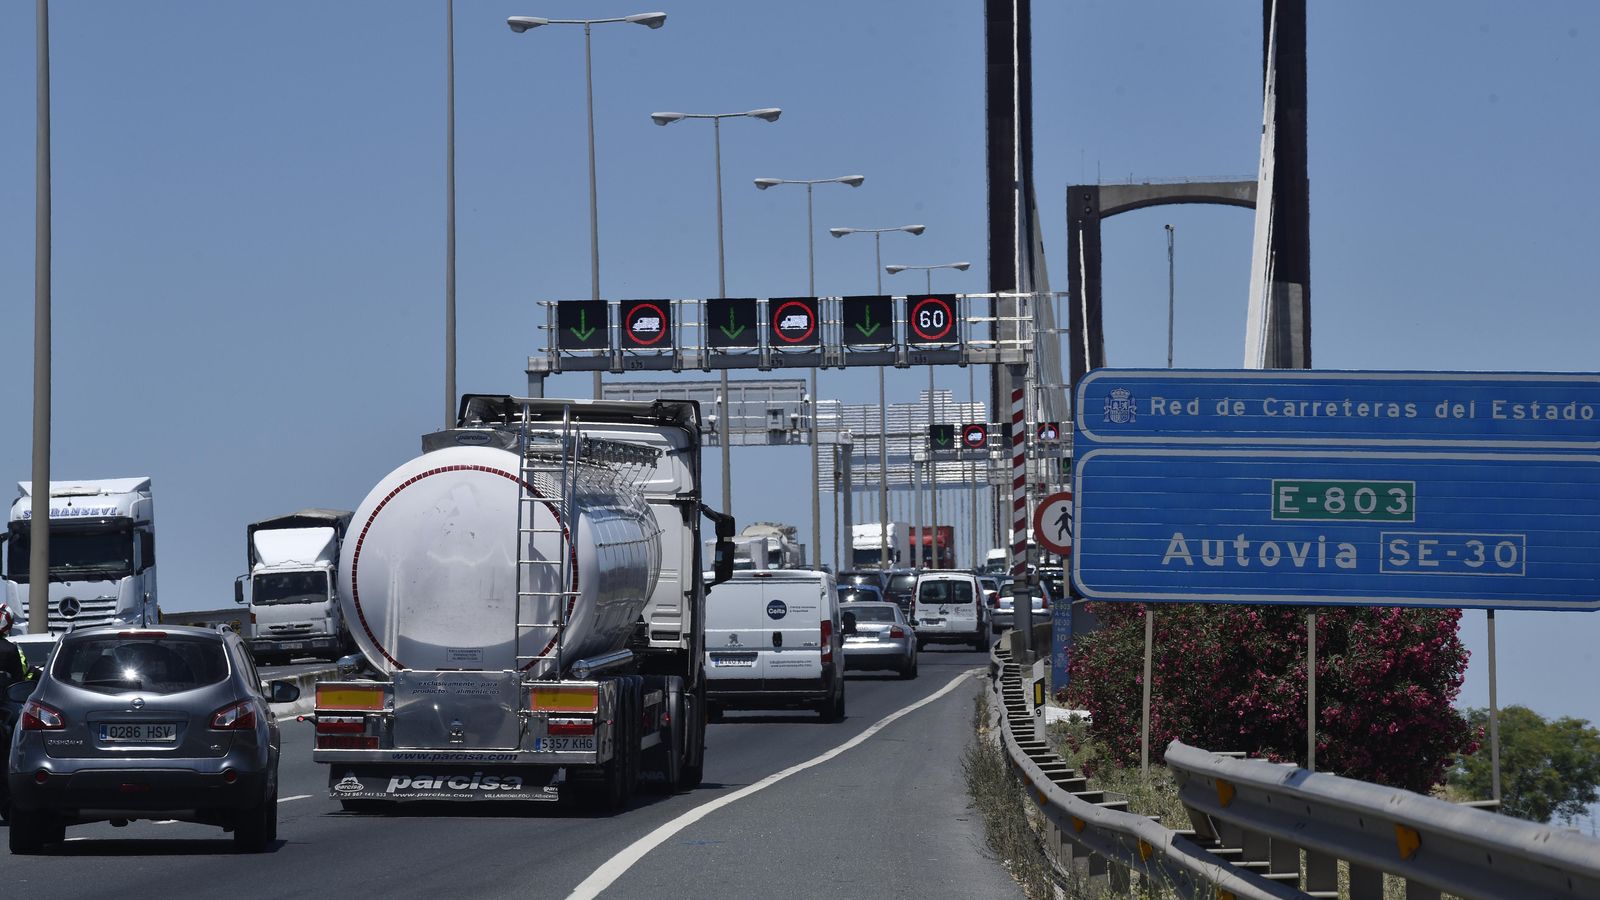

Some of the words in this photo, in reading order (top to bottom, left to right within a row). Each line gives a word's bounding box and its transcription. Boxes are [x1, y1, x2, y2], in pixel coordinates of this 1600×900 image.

[920, 310, 944, 328] 60
[1150, 396, 1200, 417] Red
[1215, 397, 1246, 417] de
[1262, 397, 1418, 419] Carreteras
[1435, 398, 1477, 419] del
[1492, 399, 1595, 421] Estado
[1279, 486, 1409, 515] E-803
[1161, 532, 1357, 569] Autovia
[1388, 539, 1519, 569] SE-30
[109, 726, 141, 739] 0286
[147, 726, 172, 739] HSV
[542, 738, 569, 749] 5357
[572, 738, 593, 749] KHG
[392, 752, 518, 762] www.parcisa.com
[386, 772, 523, 793] parcisa
